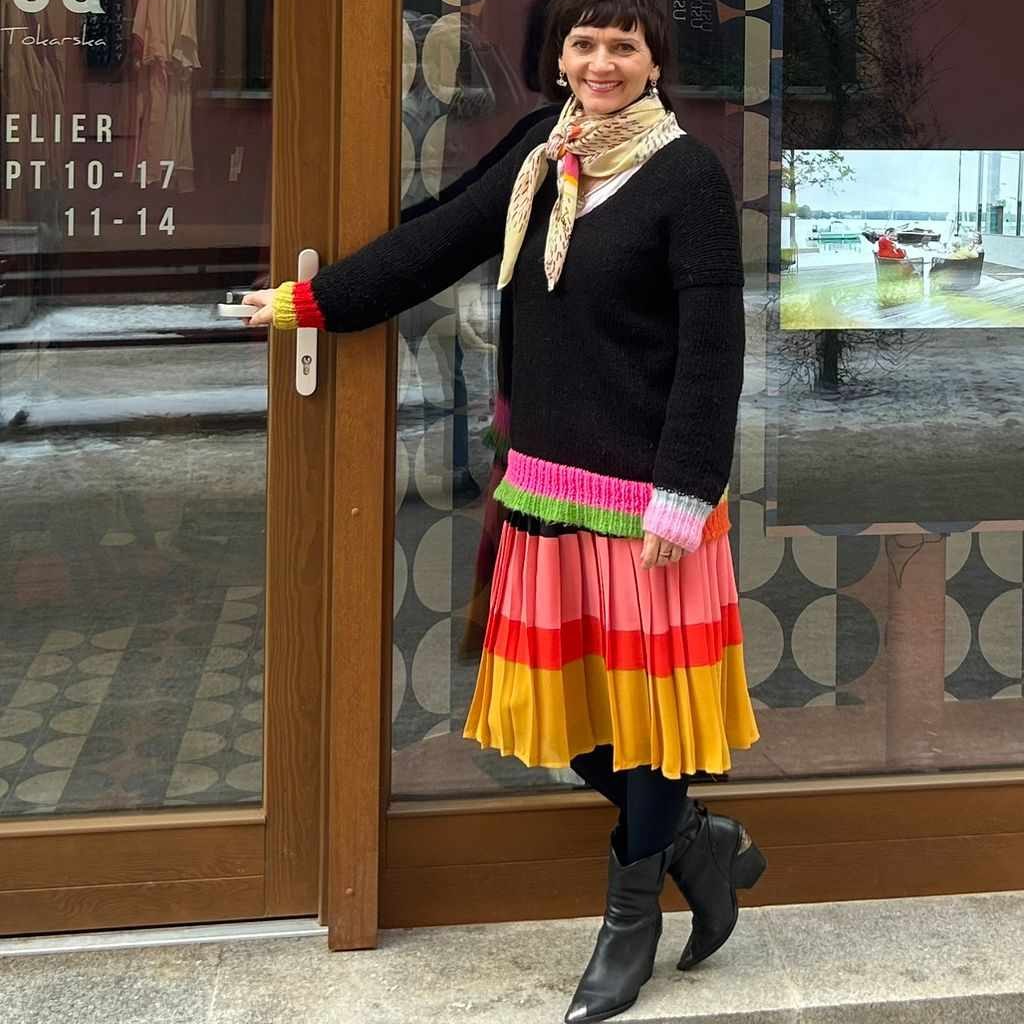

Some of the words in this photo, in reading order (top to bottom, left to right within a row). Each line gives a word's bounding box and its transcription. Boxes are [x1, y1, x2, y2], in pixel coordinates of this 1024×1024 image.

[0, 23, 107, 46] Tokarska
[5, 113, 113, 143] ELIER
[5, 160, 46, 190] PT
